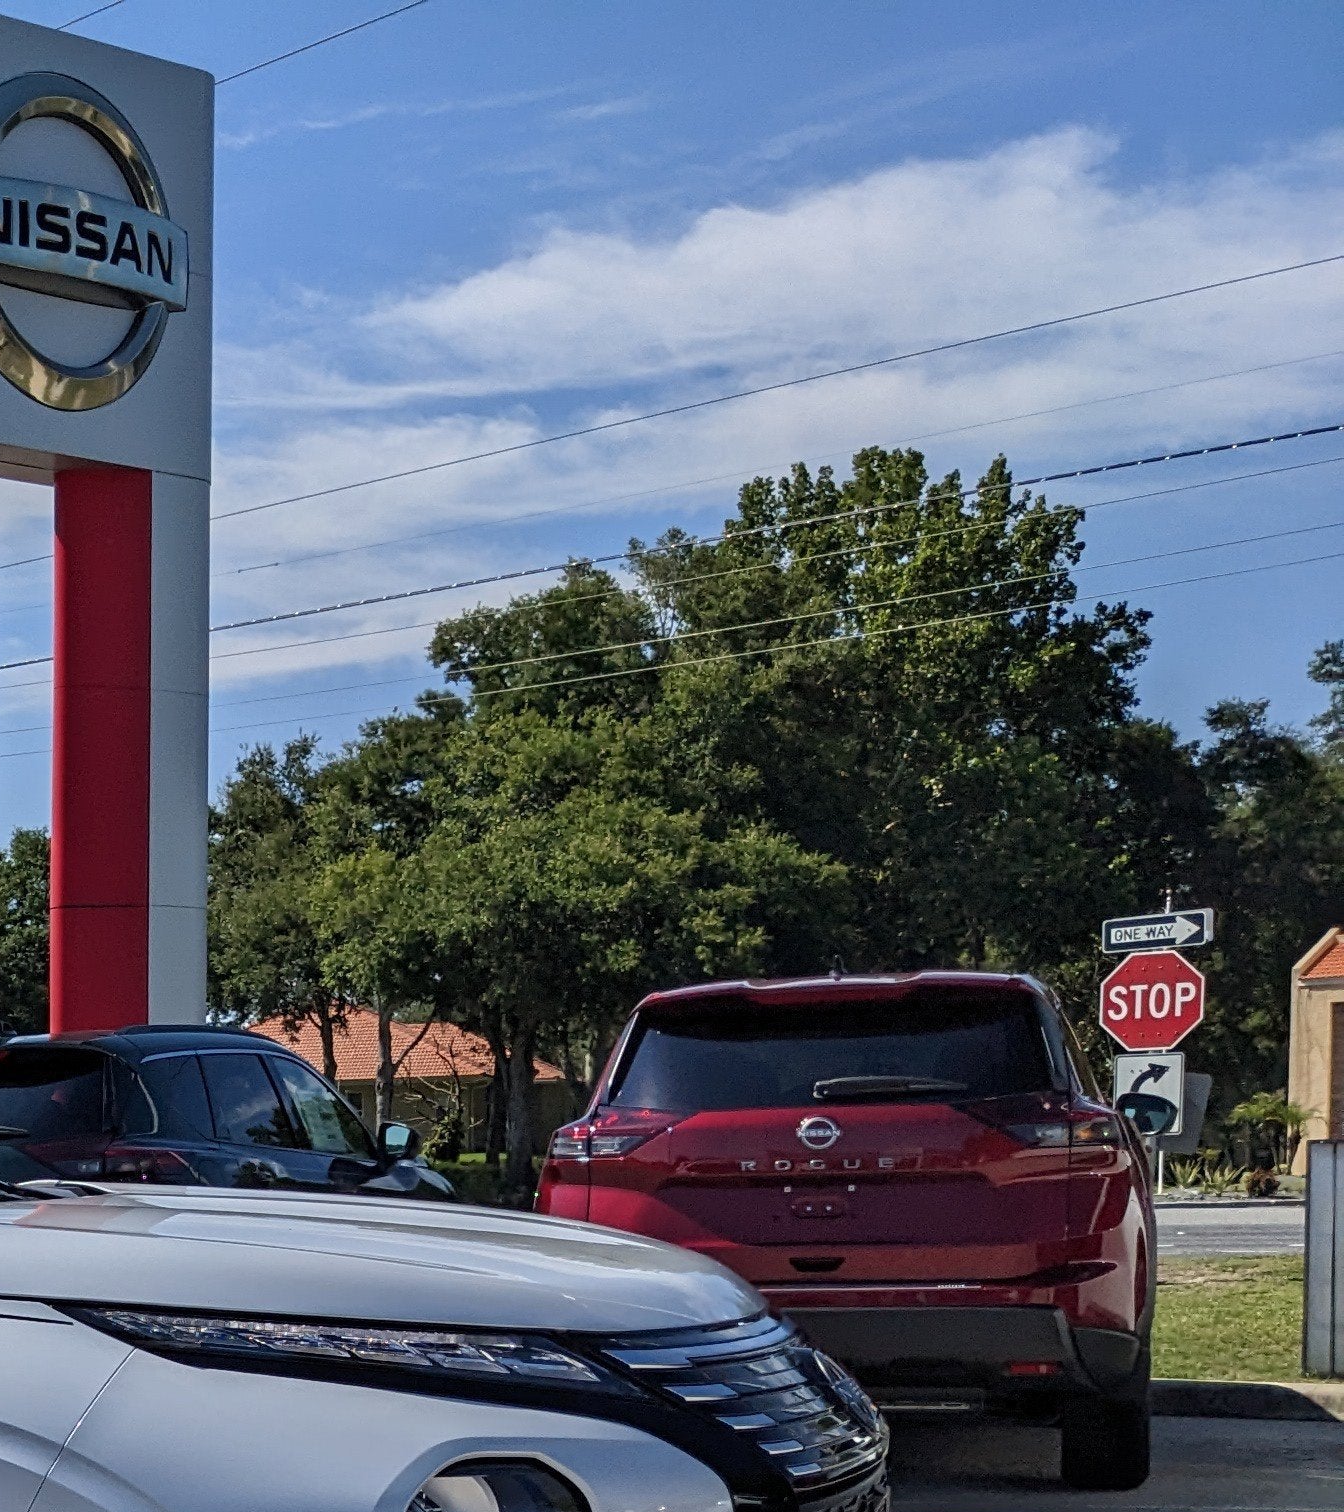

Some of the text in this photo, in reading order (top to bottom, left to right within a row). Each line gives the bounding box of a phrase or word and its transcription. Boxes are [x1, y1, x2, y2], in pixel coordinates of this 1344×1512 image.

[1114, 924, 1174, 942] ONE WAY
[1107, 981, 1196, 1021] STOP
[796, 1129, 841, 1138] NISSAN
[740, 1157, 894, 1172] ROGUE
